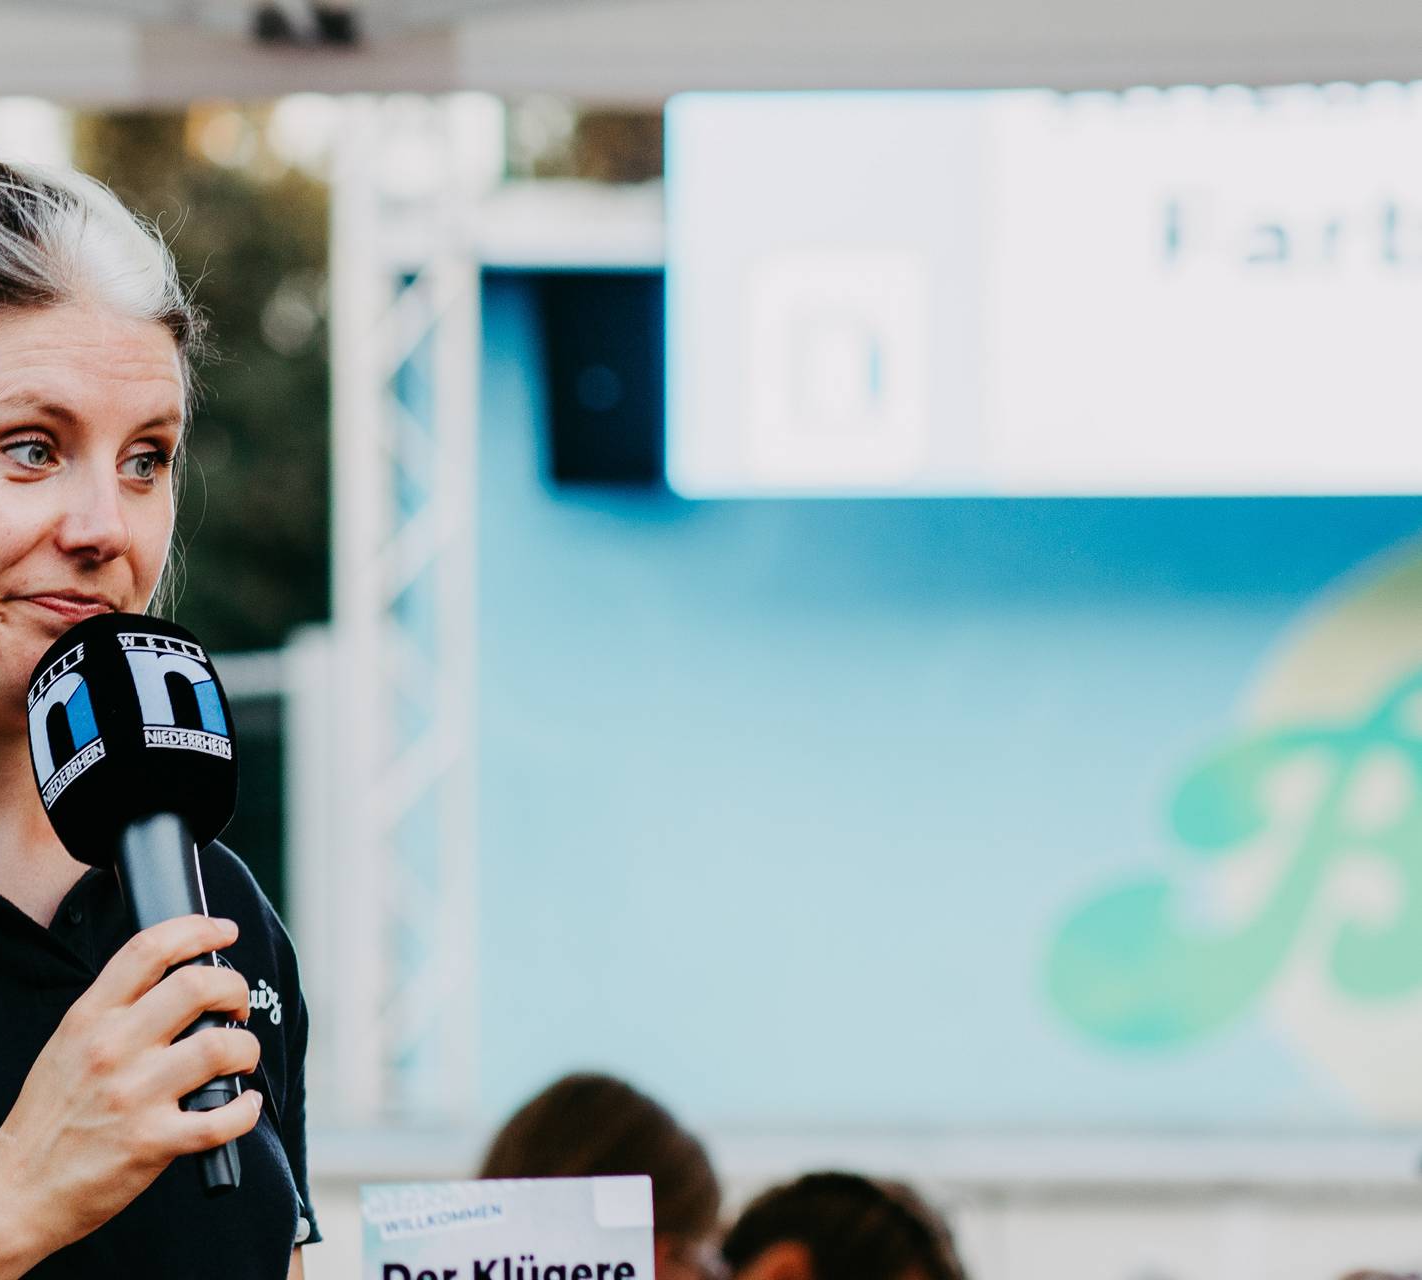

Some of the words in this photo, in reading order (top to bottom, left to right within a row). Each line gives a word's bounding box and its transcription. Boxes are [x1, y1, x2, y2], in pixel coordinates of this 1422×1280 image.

[119, 636, 206, 662] WELLE
[144, 730, 232, 757] NIEDERRHEIN
[42, 742, 106, 806] NIEDERRHEIN
[248, 979, 282, 1025] uiz
[384, 1204, 503, 1233] WILLKOMMEN
